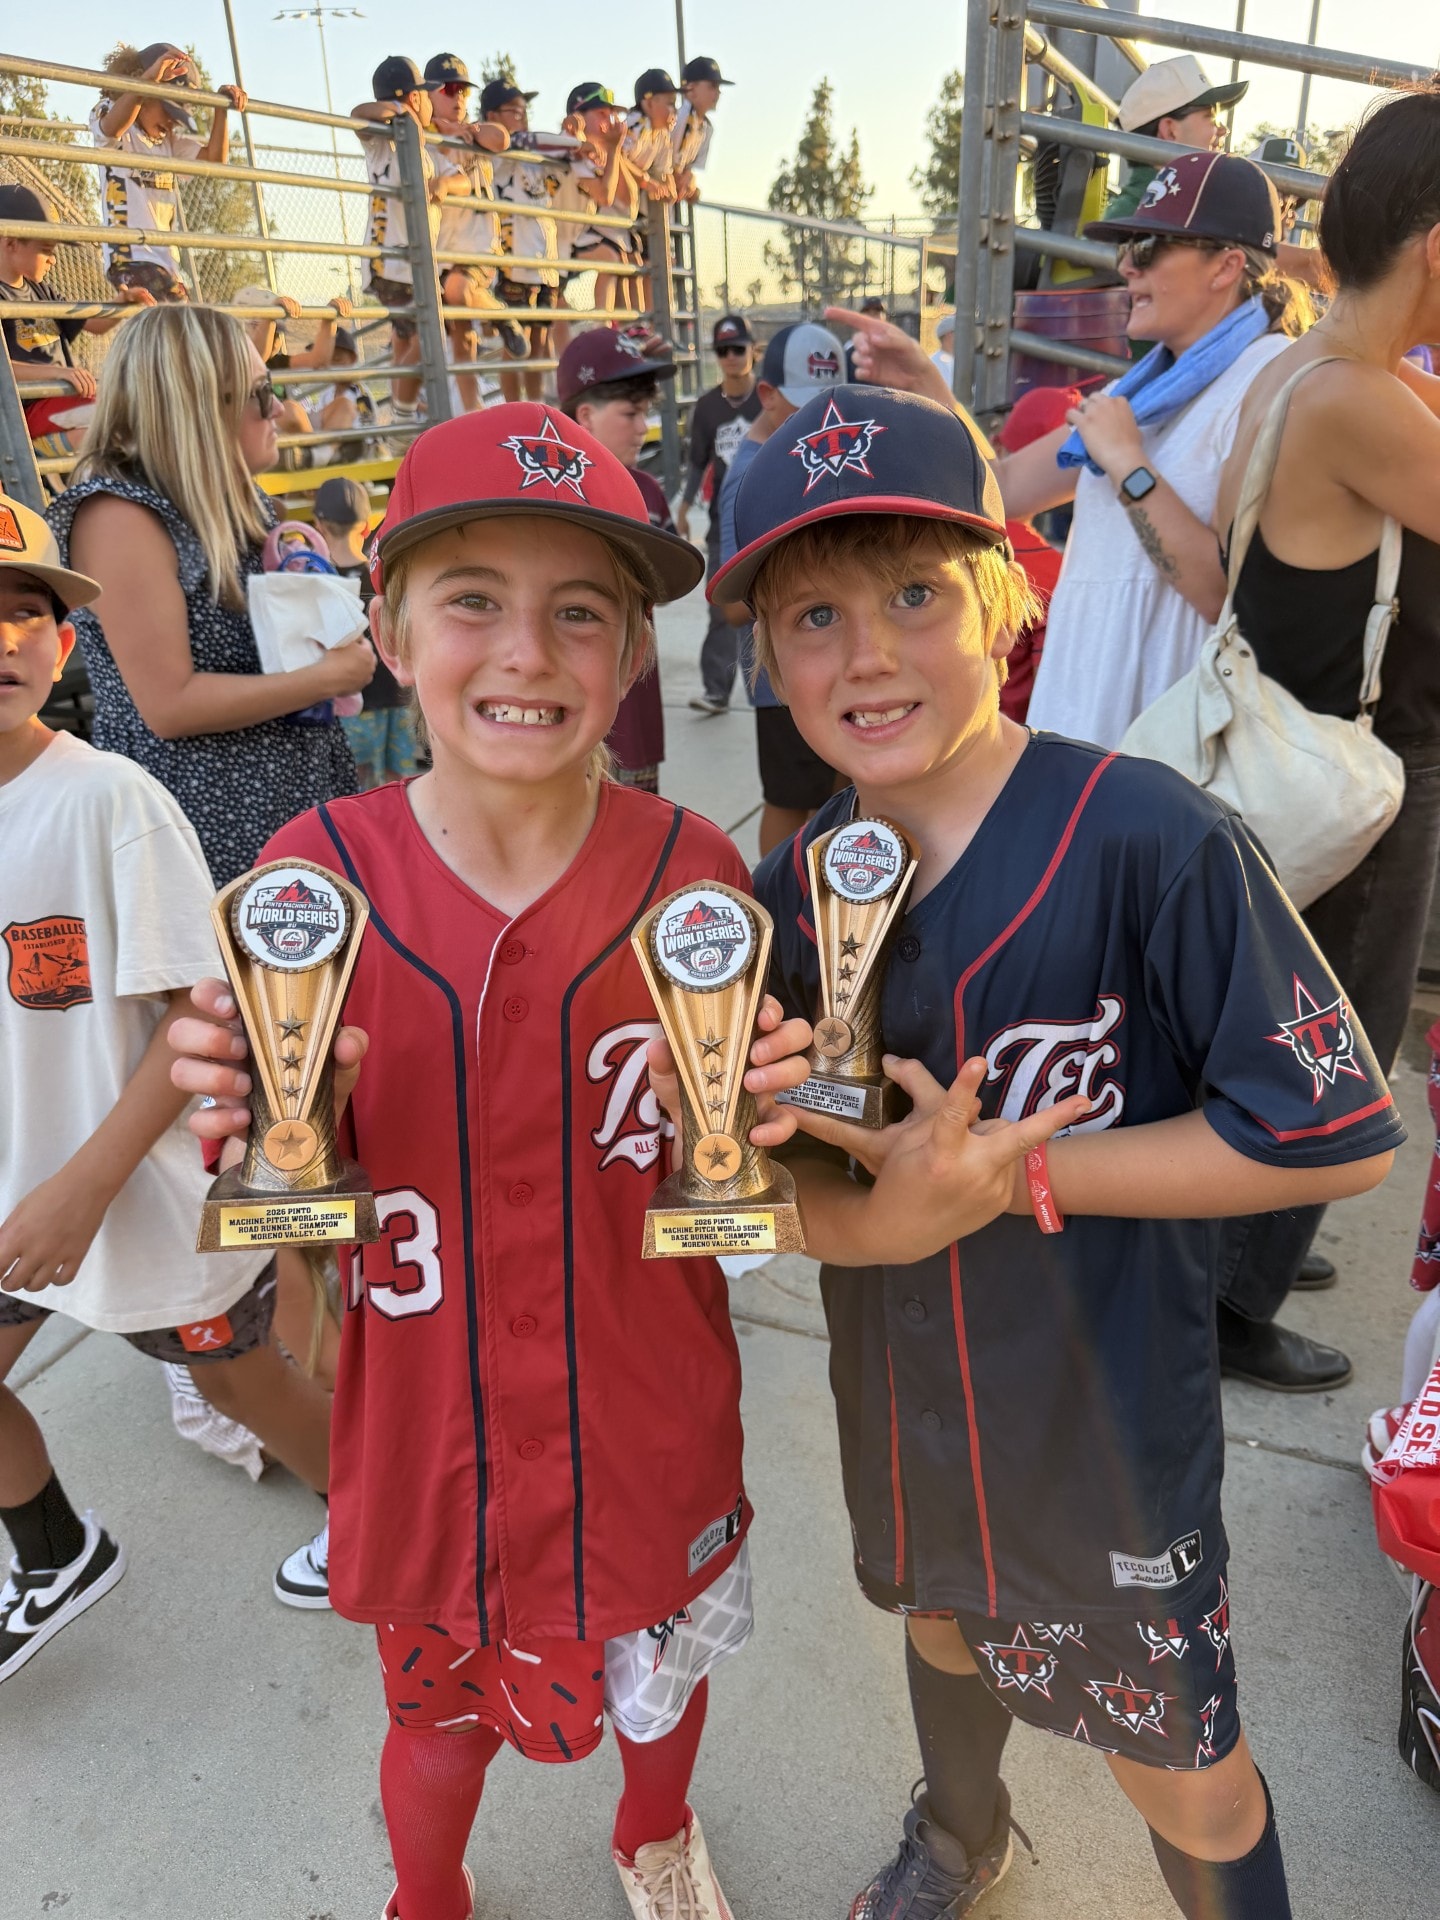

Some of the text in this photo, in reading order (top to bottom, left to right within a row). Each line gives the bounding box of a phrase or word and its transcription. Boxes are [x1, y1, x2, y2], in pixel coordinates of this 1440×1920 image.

[833, 851, 895, 871] WORLD SERIES
[250, 908, 337, 929] WORLD SERIES
[11, 923, 87, 942] BASEBALLIS
[676, 919, 727, 934] PINTO MACHINE PITCH
[23, 939, 66, 950] ESTABLISHED
[666, 925, 744, 954] WORLD SERIES
[818, 1083, 835, 1091] PINTO
[790, 1096, 813, 1105] MORENO
[798, 1091, 810, 1099] THE
[811, 1094, 825, 1102] HORN
[829, 1097, 840, 1106] 2ND
[841, 1100, 859, 1109] PLACE
[820, 1090, 839, 1099] WORLD
[840, 1094, 860, 1103] SERIES
[634, 1138, 660, 1155] ALL-S
[288, 1207, 311, 1215] PINTO
[1040, 1203, 1052, 1226] WORLD
[229, 1218, 265, 1226] MACHINE
[266, 1216, 290, 1224] PITCH
[320, 1212, 348, 1220] SERIES
[694, 1218, 712, 1226] 2026
[238, 1226, 259, 1234] ROAD
[261, 1224, 292, 1232] RUNNER
[299, 1221, 339, 1230] CHAMPION
[251, 1232, 283, 1241] MORENO
[691, 1526, 725, 1560] TECOLOTE
[1173, 1538, 1197, 1554] YOUTH
[1116, 1562, 1171, 1575] TECOLOTE
[1178, 1550, 1196, 1573] L
[1130, 1573, 1175, 1584] Authentic
